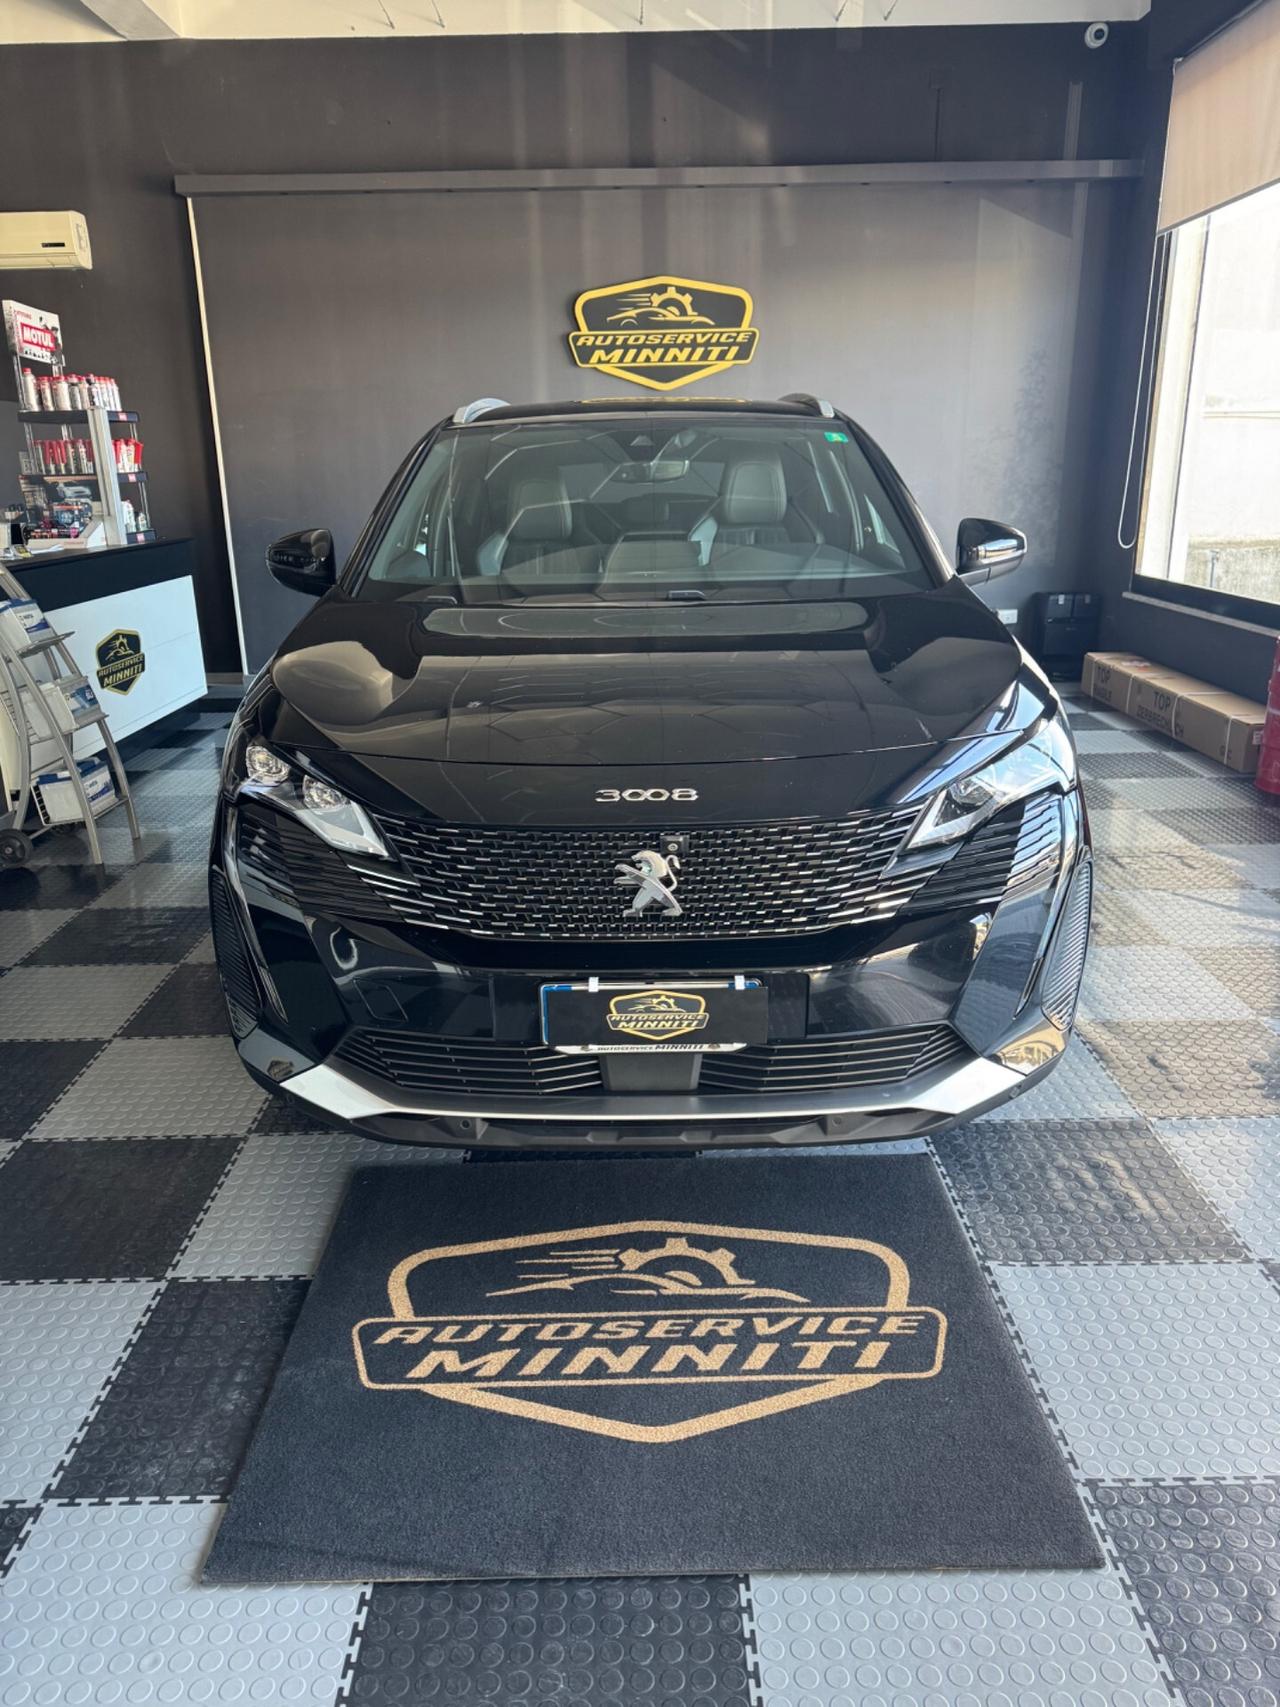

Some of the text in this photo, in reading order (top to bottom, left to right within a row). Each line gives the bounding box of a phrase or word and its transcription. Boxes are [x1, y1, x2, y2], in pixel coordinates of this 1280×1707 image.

[23, 325, 54, 348] MOTUL
[576, 332, 752, 346] AUTOSERVICE
[588, 346, 740, 364] MINNITI
[98, 654, 144, 677] AUTOSERVICE
[103, 663, 143, 687] MINNITI
[1153, 690, 1171, 712] TOP
[595, 788, 699, 802] 3008
[610, 1013, 706, 1021] AUTOSERVICE
[617, 1020, 700, 1029] MINNITI
[373, 1314, 926, 1345] AUTOSERVICE
[405, 1341, 893, 1379] MINNITI
